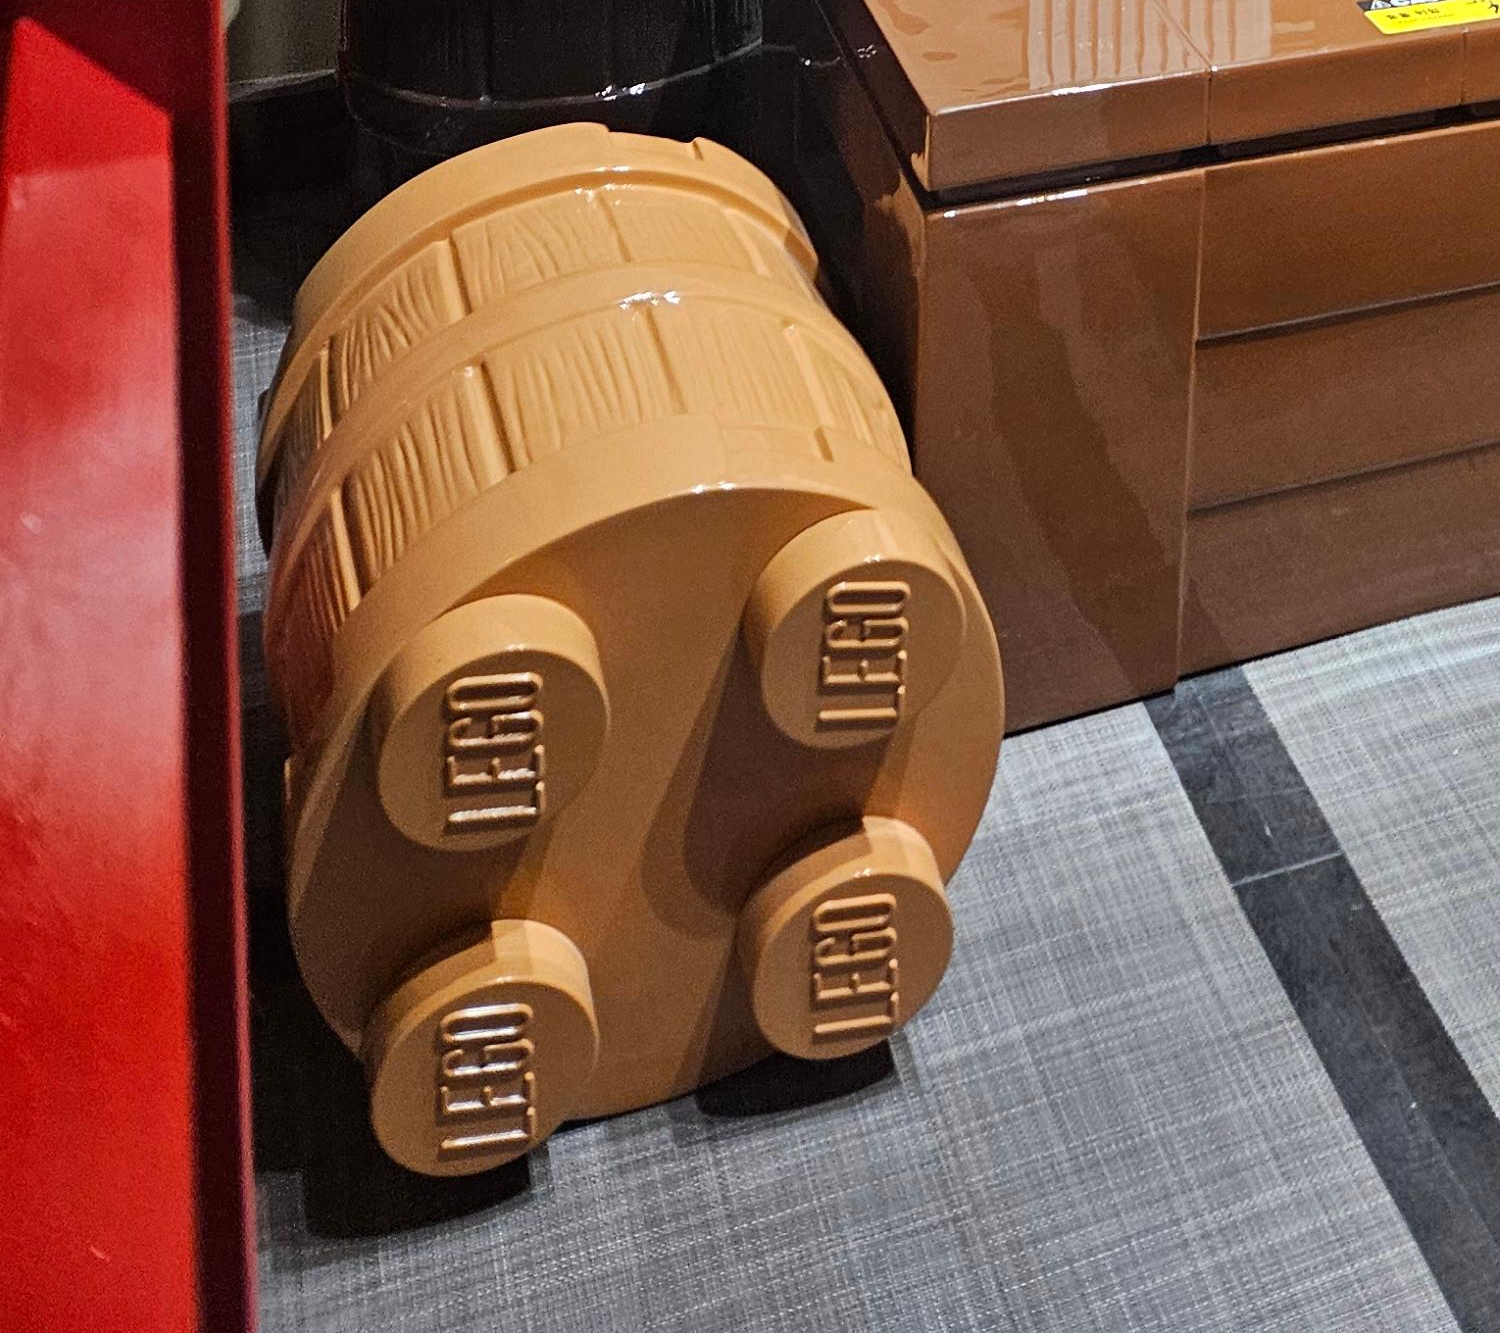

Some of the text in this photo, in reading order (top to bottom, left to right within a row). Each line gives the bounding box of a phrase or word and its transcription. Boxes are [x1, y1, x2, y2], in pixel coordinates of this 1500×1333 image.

[816, 580, 912, 729] LEGO
[444, 671, 544, 827] LEGO
[811, 893, 898, 1035] LEGO
[440, 1002, 535, 1150] LEGO
